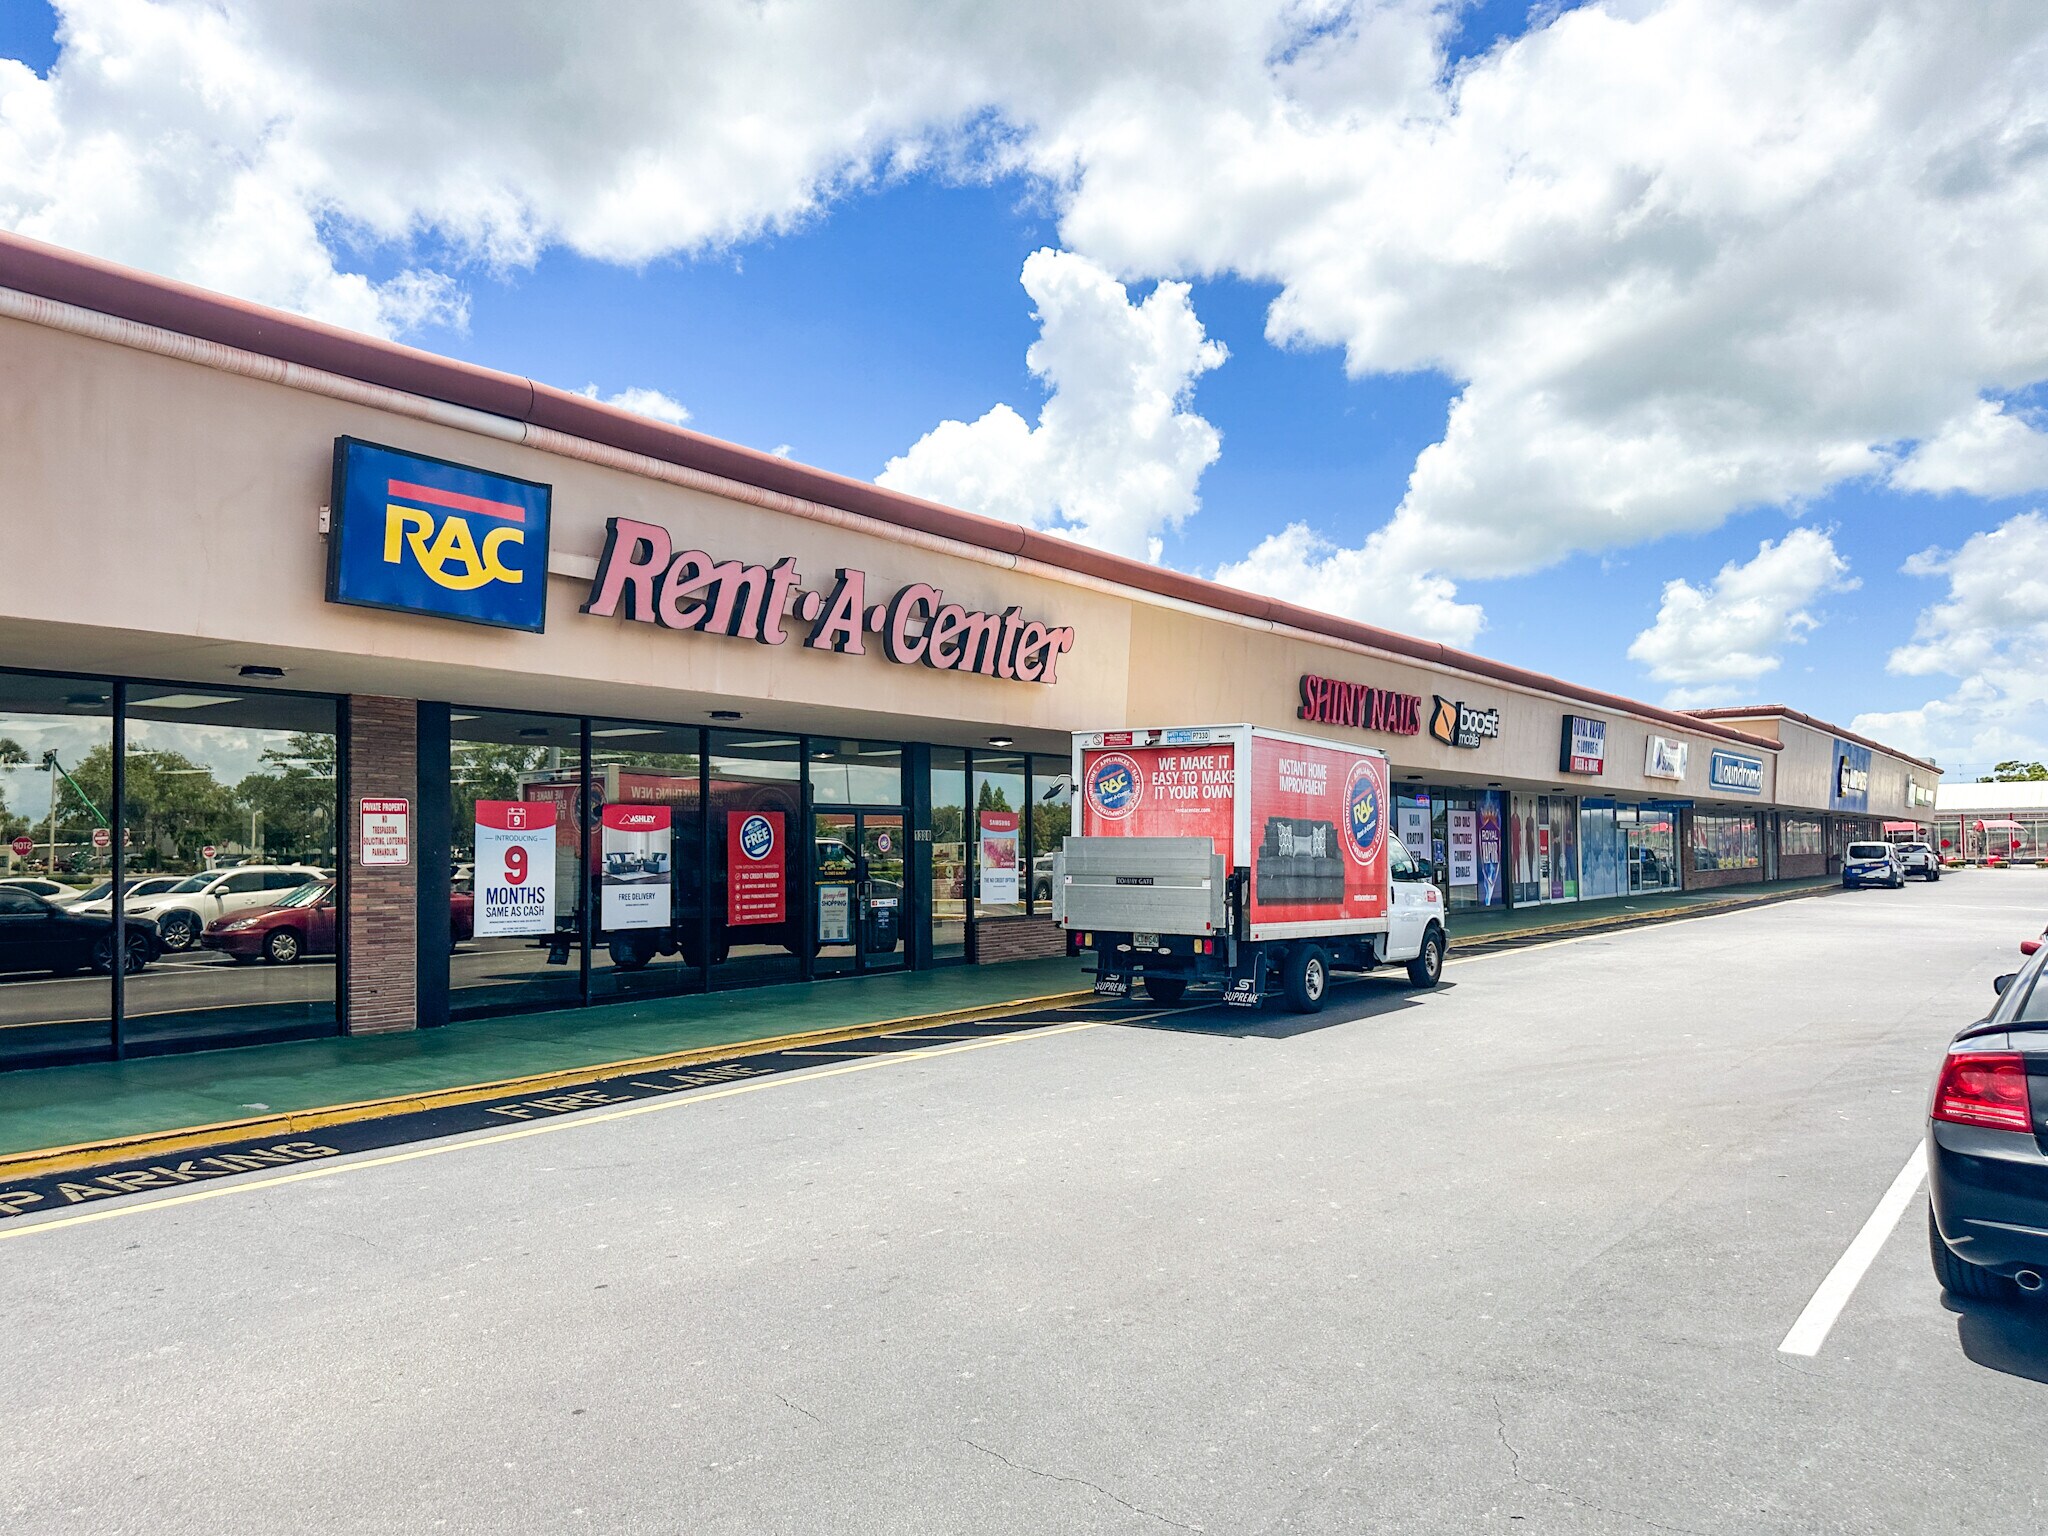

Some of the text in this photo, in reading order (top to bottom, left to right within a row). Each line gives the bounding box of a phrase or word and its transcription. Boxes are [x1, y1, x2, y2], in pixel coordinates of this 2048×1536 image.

[384, 503, 525, 591] RAC
[1297, 674, 1421, 736] SHINY NAILS
[1459, 703, 1499, 738] boost
[1573, 717, 1588, 739] ROYAL
[1458, 734, 1480, 747] mobile
[1099, 756, 1130, 767] APPLIANCES
[1158, 754, 1229, 771] WE MAKE IT
[1278, 758, 1327, 780] INSTANT HOME
[1718, 756, 1764, 789] Laundromat
[1152, 769, 1234, 785] EASY TO MAKE
[1099, 773, 1128, 796] RAC
[1279, 775, 1327, 796] IMPROVEMENT
[1154, 784, 1232, 800] IT YOUR OWN
[363, 802, 406, 812] PRIVATE PROPERTY
[1353, 794, 1375, 825] RAC
[381, 815, 388, 823] NO
[513, 815, 521, 826] 9
[630, 814, 656, 824] ASHLEY
[989, 819, 1011, 827] SAMSUNG
[1374, 789, 1384, 846] ELECTRONICS
[1409, 814, 1420, 826] KAVA
[1453, 816, 1471, 828] CBD OILS
[372, 825, 397, 834] TRESPASSING
[1481, 829, 1498, 840] ROYAL
[494, 834, 538, 843] INTRODUCING
[744, 827, 770, 849] FREE
[1406, 832, 1424, 845] KRATOM
[1452, 833, 1472, 845] TINCTURES
[371, 848, 398, 857] PANHANDLING
[1454, 850, 1472, 862] GUMMIES
[1482, 841, 1498, 864] VAPOR
[504, 845, 528, 885] 9
[1455, 866, 1471, 878] EDIBLES
[486, 886, 545, 906] MONTHS
[618, 892, 656, 902] FREE DELIVERY
[486, 905, 545, 918] SAME AS CASH
[1095, 981, 1127, 993] SUPREME
[1222, 991, 1259, 1004] SUPREME
[630, 1063, 773, 1097] LANE
[486, 1088, 634, 1121] FIRE
[0, 1140, 340, 1217] PARKING
